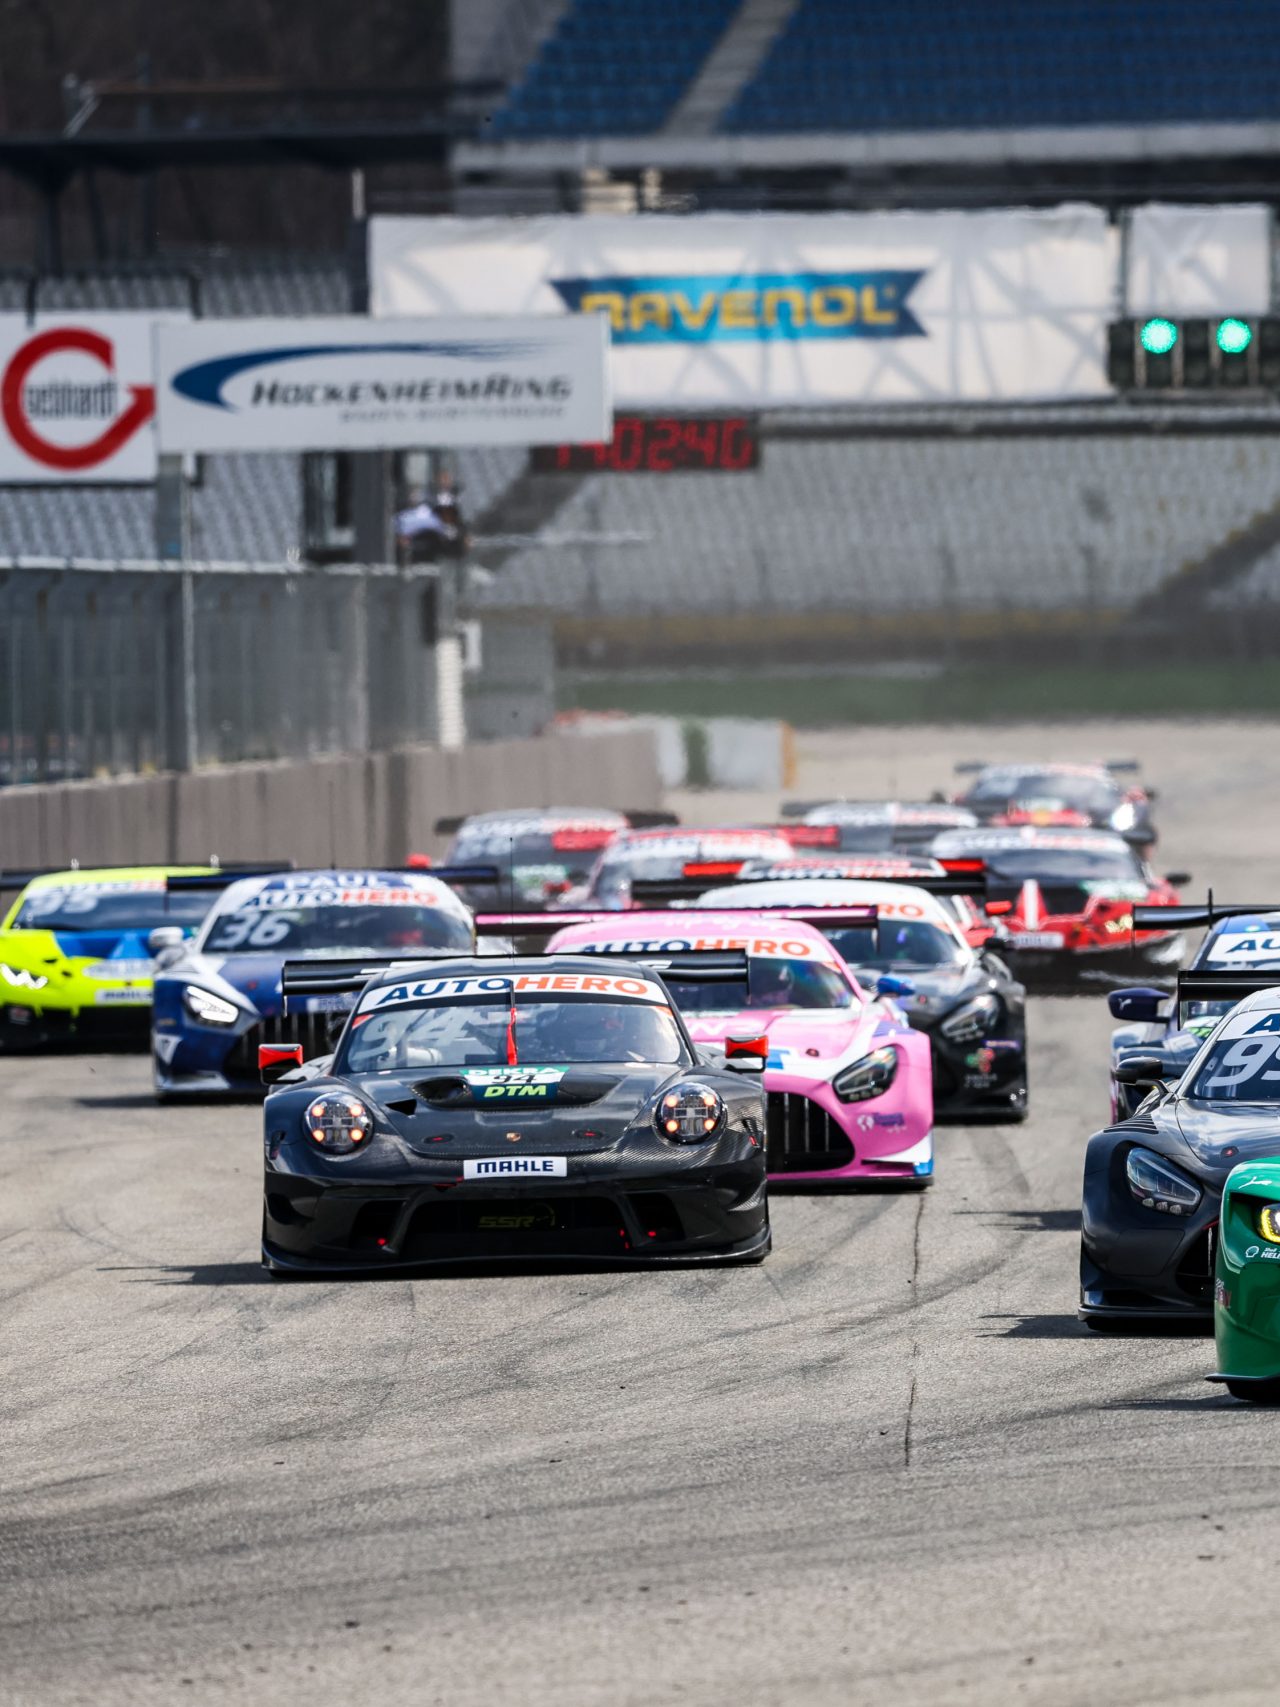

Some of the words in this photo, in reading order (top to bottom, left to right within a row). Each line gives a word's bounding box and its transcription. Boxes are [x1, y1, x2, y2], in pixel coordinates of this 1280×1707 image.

[245, 889, 439, 909] AUTOHERO
[210, 912, 302, 949] 36
[375, 976, 649, 1006] AUTOHERO
[468, 1066, 560, 1075] DEKRA
[490, 1074, 537, 1084] 94
[484, 1085, 547, 1098] DTM
[477, 1160, 554, 1174] MAHLE
[478, 1216, 535, 1228] SSR
